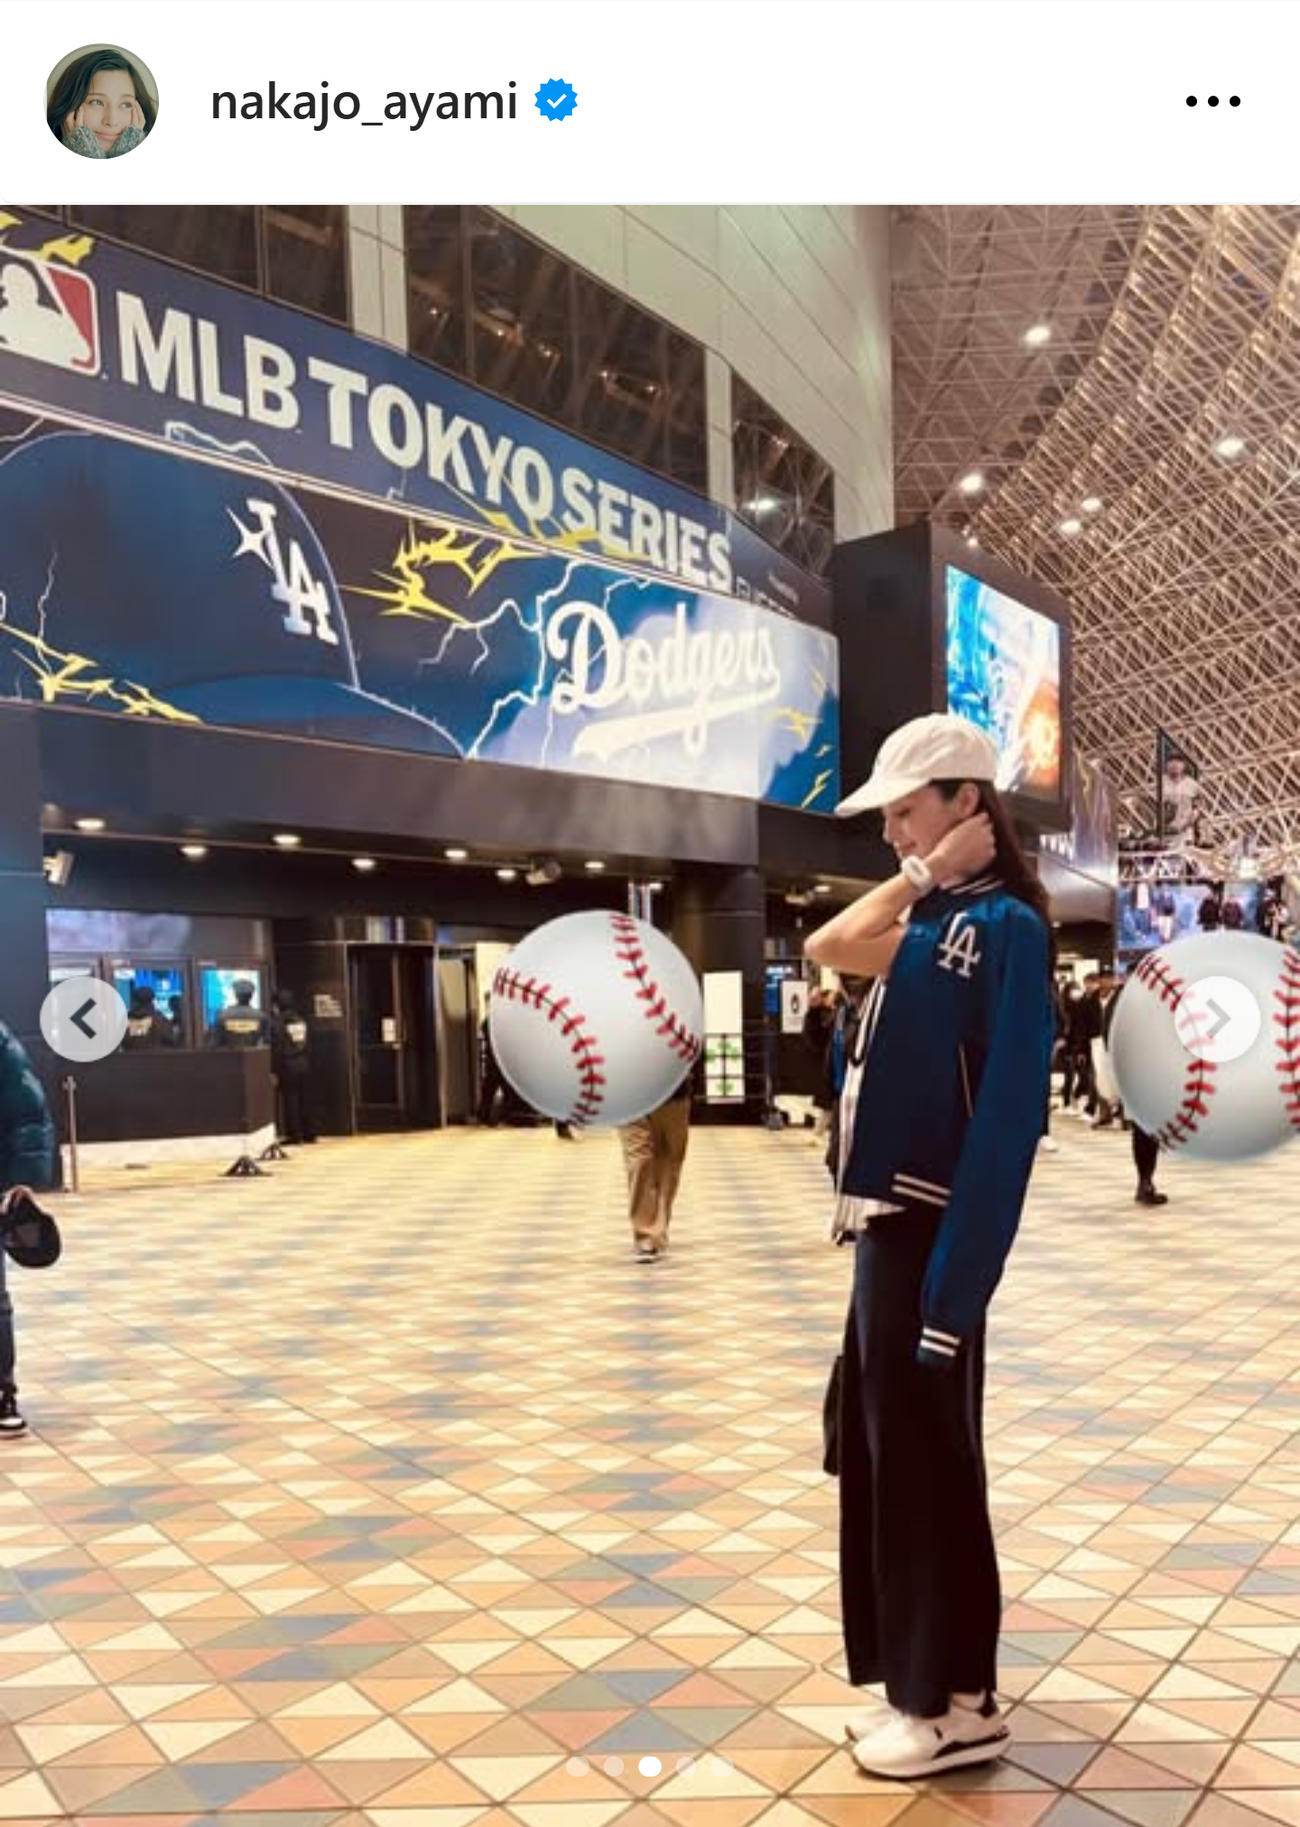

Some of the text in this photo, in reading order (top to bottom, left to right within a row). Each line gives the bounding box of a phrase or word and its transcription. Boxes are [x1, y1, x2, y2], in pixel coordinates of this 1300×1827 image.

[116, 290, 732, 593] MLB TOKYO SERIES
[247, 499, 339, 645] LA
[547, 601, 780, 755] Dodgers
[937, 911, 981, 978] LA
